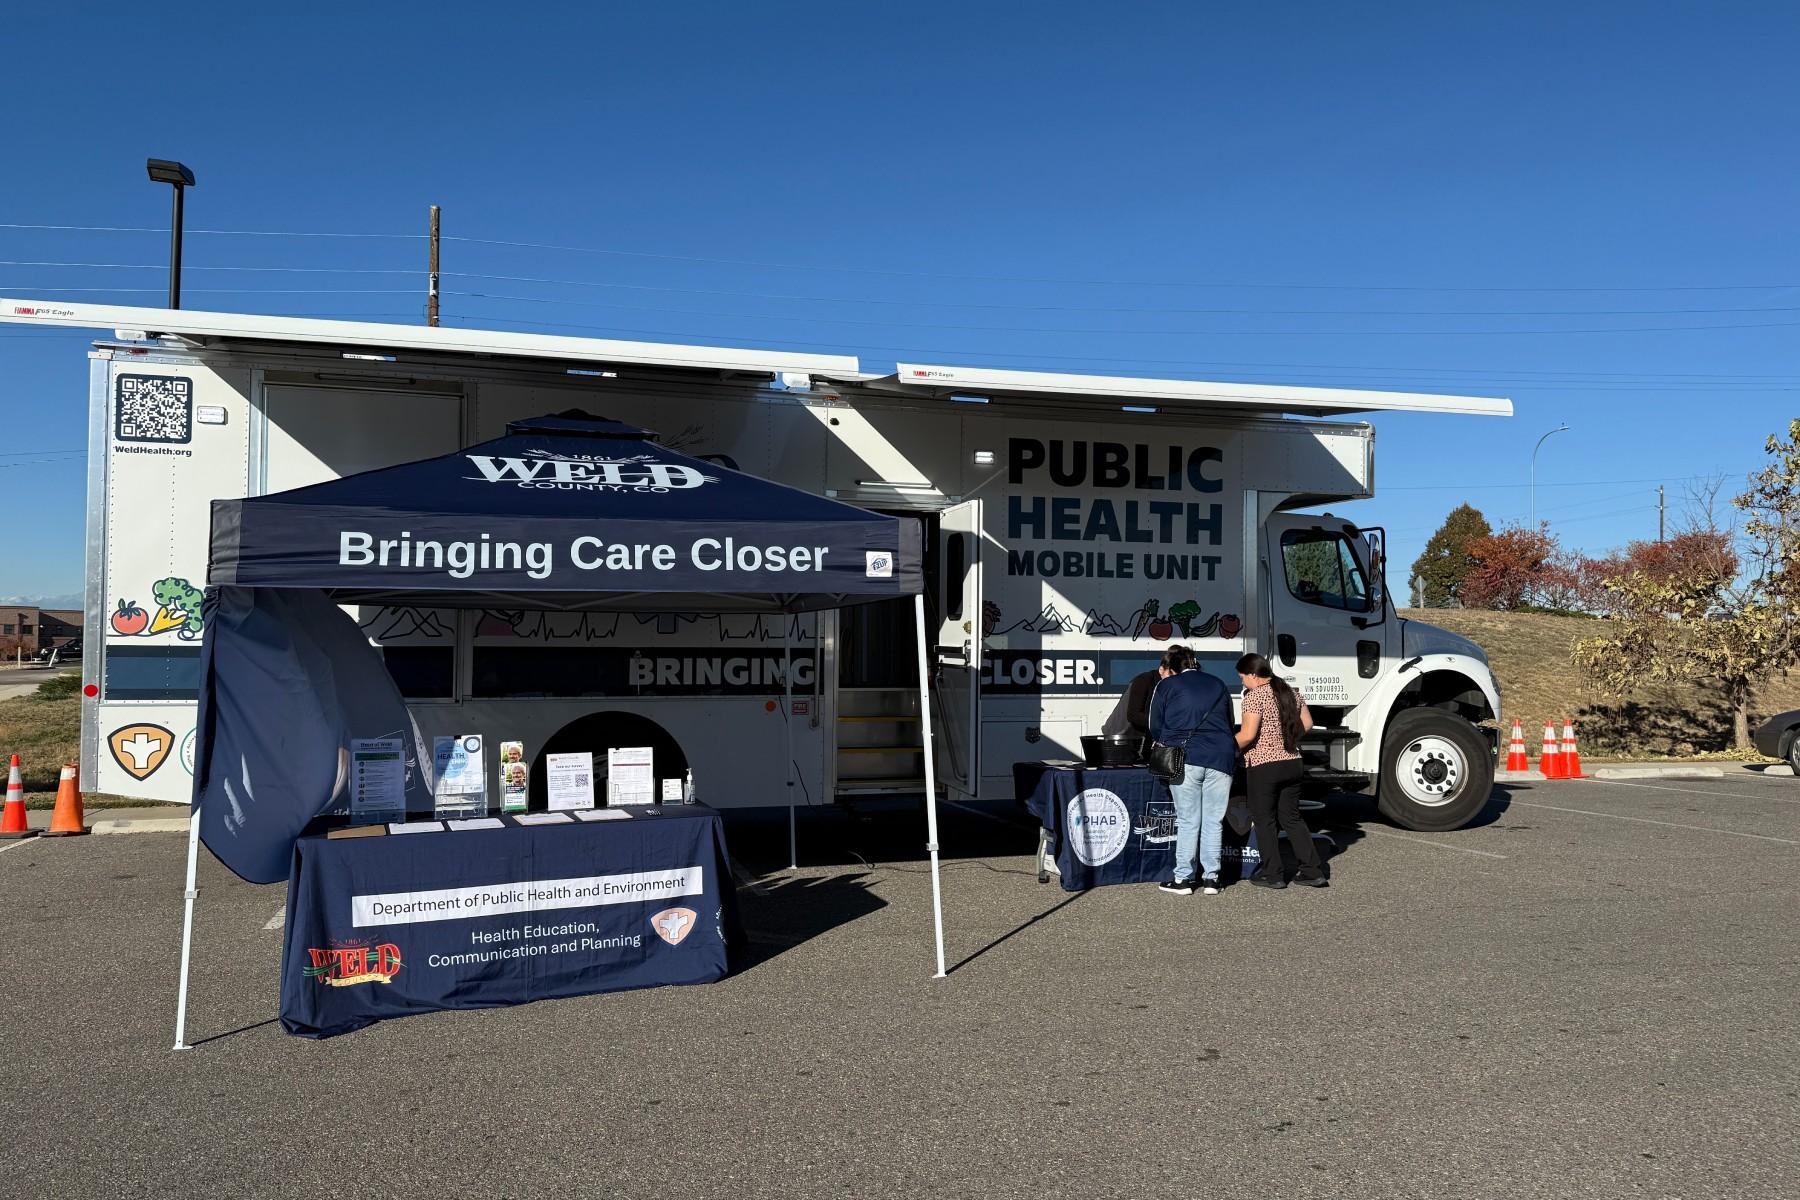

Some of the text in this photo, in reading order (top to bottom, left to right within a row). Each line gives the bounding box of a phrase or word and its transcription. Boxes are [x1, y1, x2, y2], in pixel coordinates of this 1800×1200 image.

[115, 446, 192, 457] WeldHealth.org
[1008, 437, 1223, 493] PUBLIC
[466, 454, 705, 489] WELD
[517, 482, 670, 494] COUNTY, CO
[1008, 496, 1223, 545] HEALTH
[339, 531, 829, 579] Bringing Care Closer
[1008, 549, 1222, 581] MOBILE UNIT
[629, 657, 815, 686] BRINGING
[981, 658, 1104, 685] CLOSER.
[1341, 693, 1349, 701] CO
[1083, 816, 1117, 826] PHAB
[372, 876, 685, 917] Department of Public Health and Environment
[471, 922, 600, 944] Health Education,
[308, 943, 402, 984] WELD
[428, 934, 641, 968] Communication and Planning
